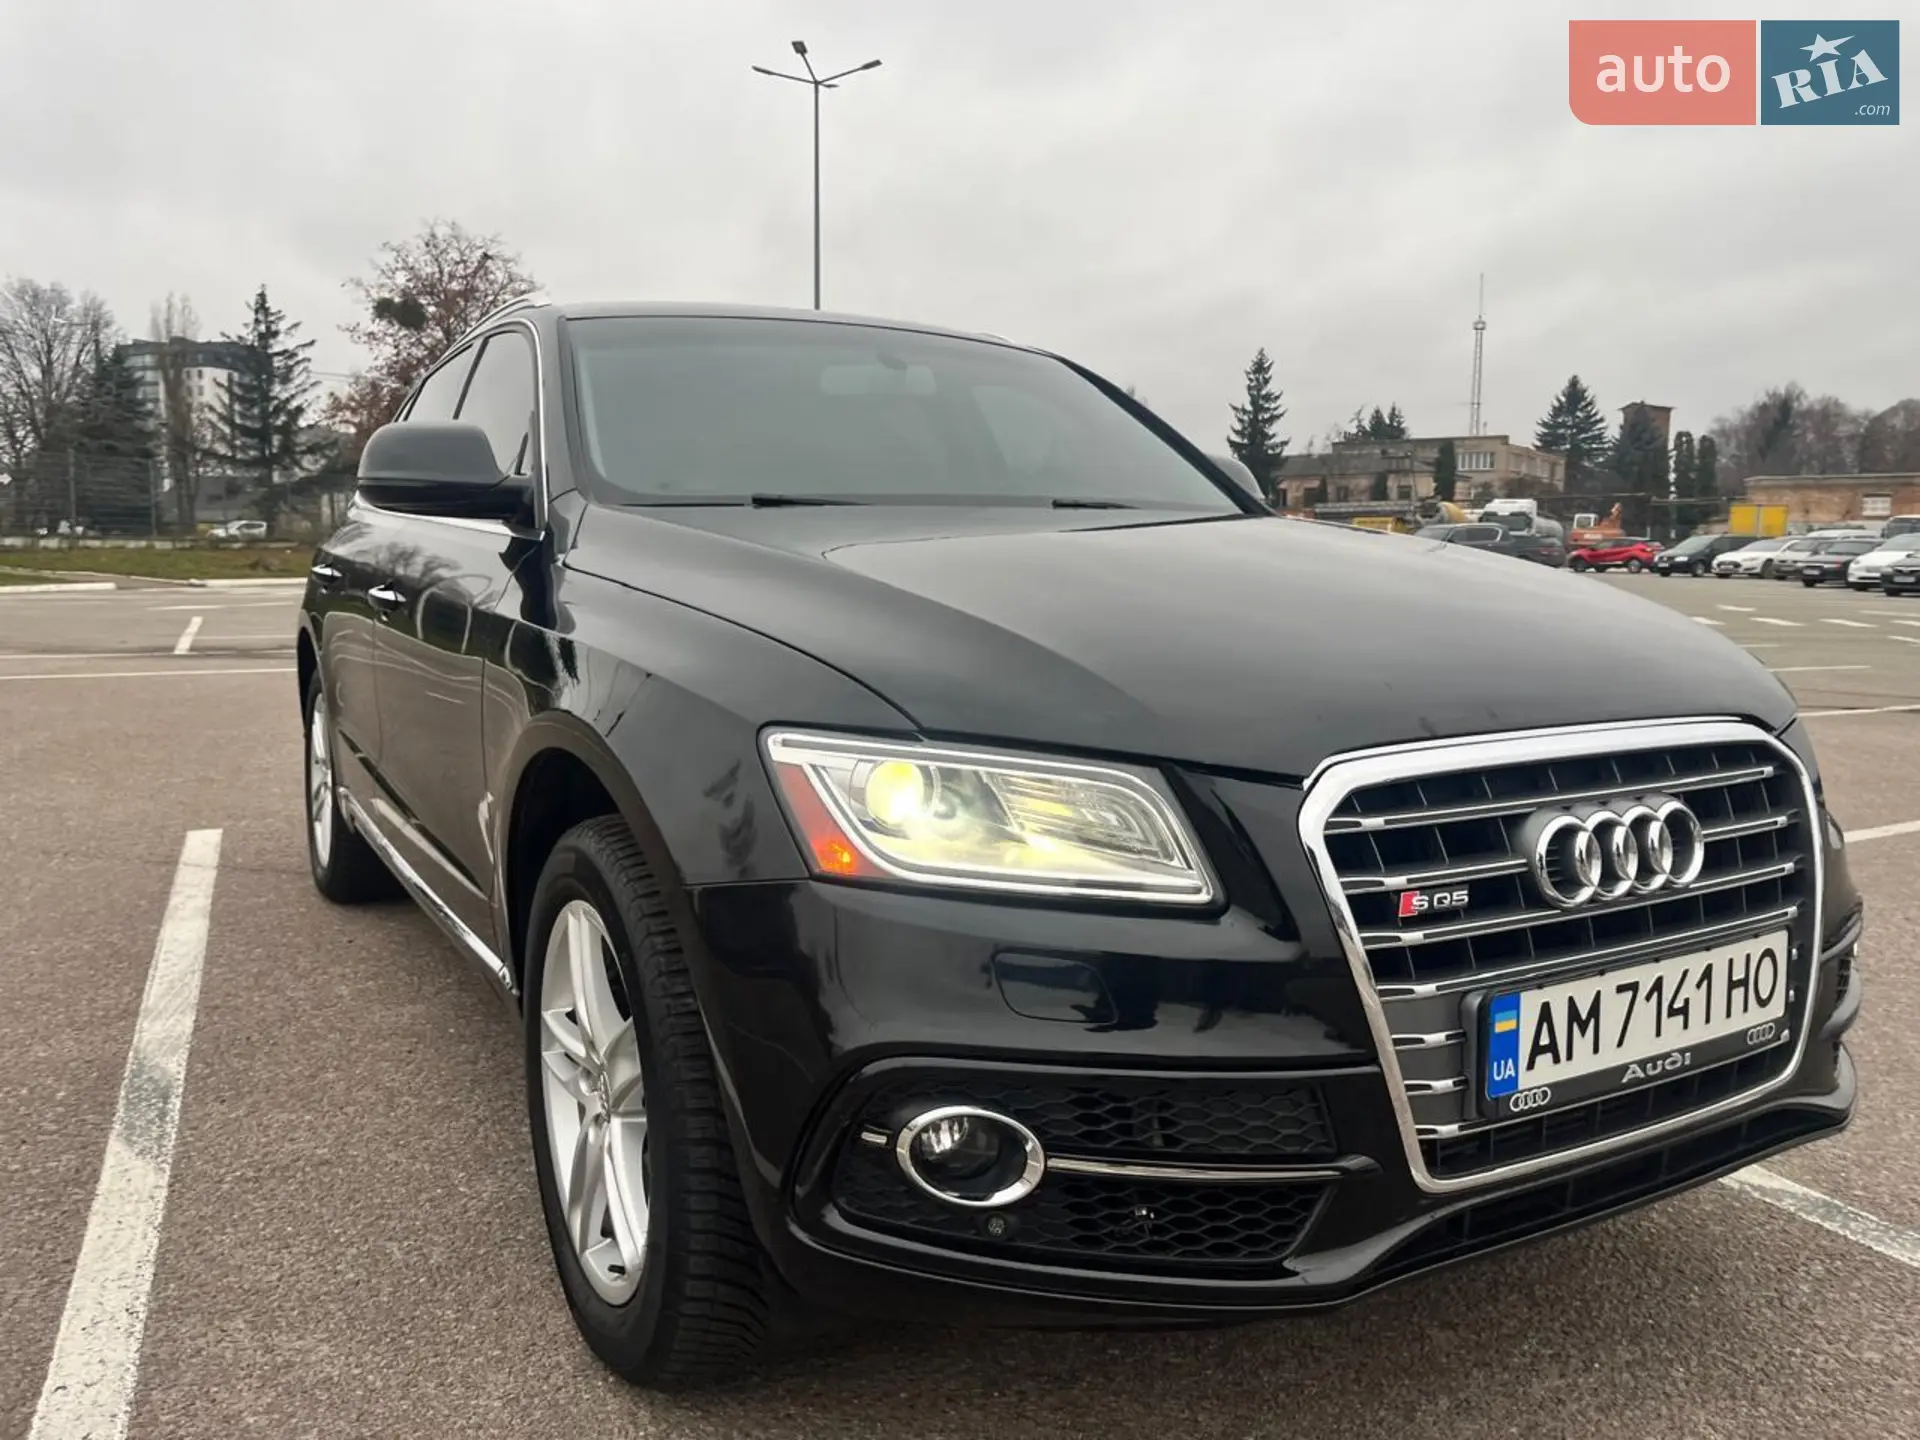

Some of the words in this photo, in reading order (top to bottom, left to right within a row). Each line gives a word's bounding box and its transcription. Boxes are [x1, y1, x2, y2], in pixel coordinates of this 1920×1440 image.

[1526, 989, 1601, 1072] AM
[1616, 963, 1714, 1049] 7141
[1726, 947, 1779, 1019] HO
[1493, 1058, 1516, 1081] UA
[1621, 1052, 1692, 1083] Audi
